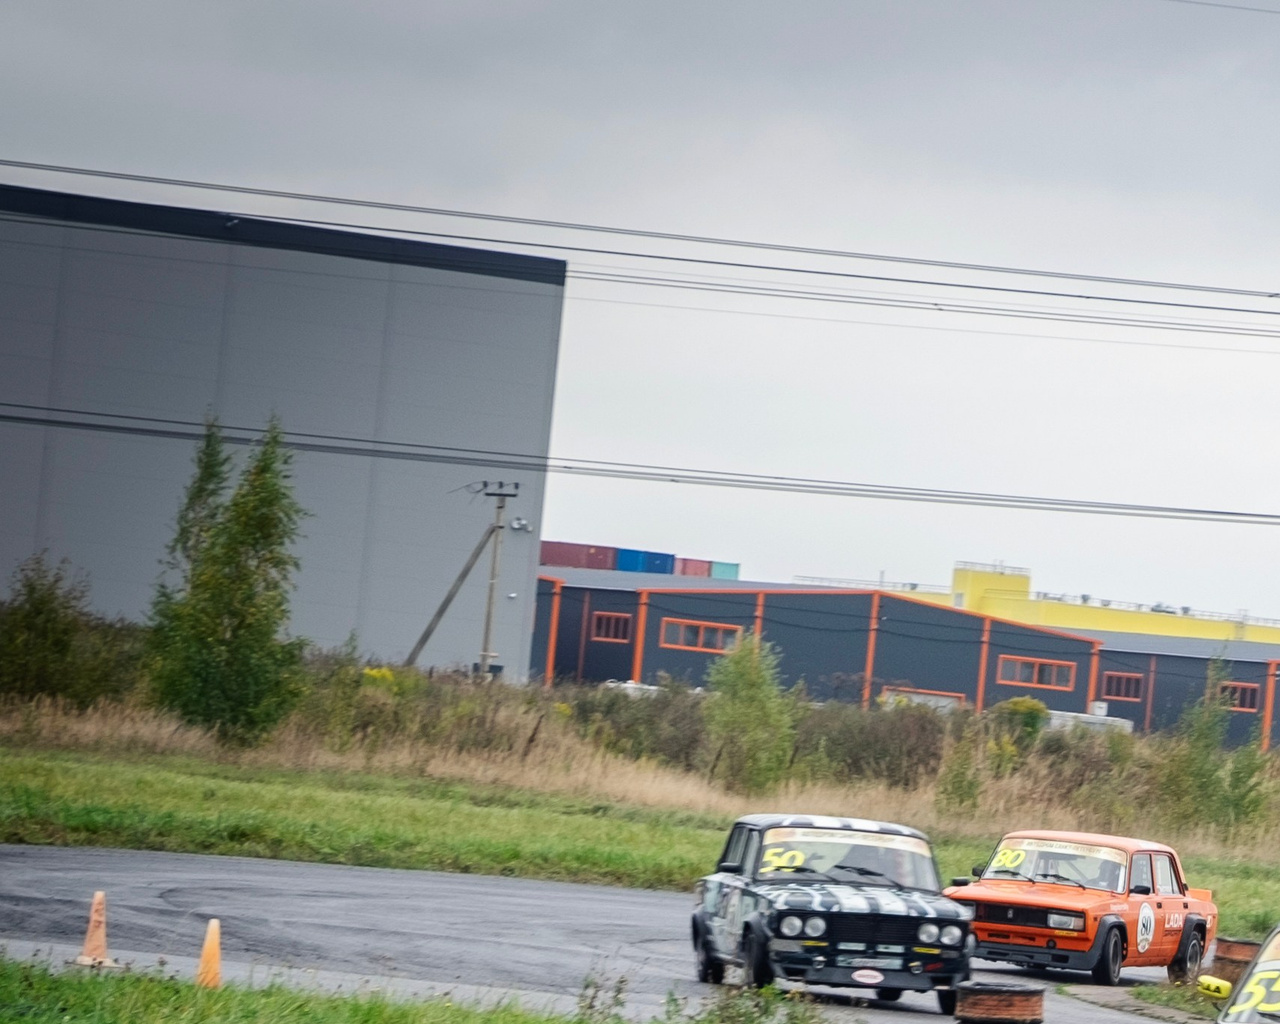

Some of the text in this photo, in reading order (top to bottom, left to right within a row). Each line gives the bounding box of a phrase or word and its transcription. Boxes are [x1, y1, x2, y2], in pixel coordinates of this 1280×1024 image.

[759, 847, 806, 874] 50
[990, 848, 1026, 869] 80
[1140, 915, 1152, 937] 80
[1165, 912, 1183, 928] LADA
